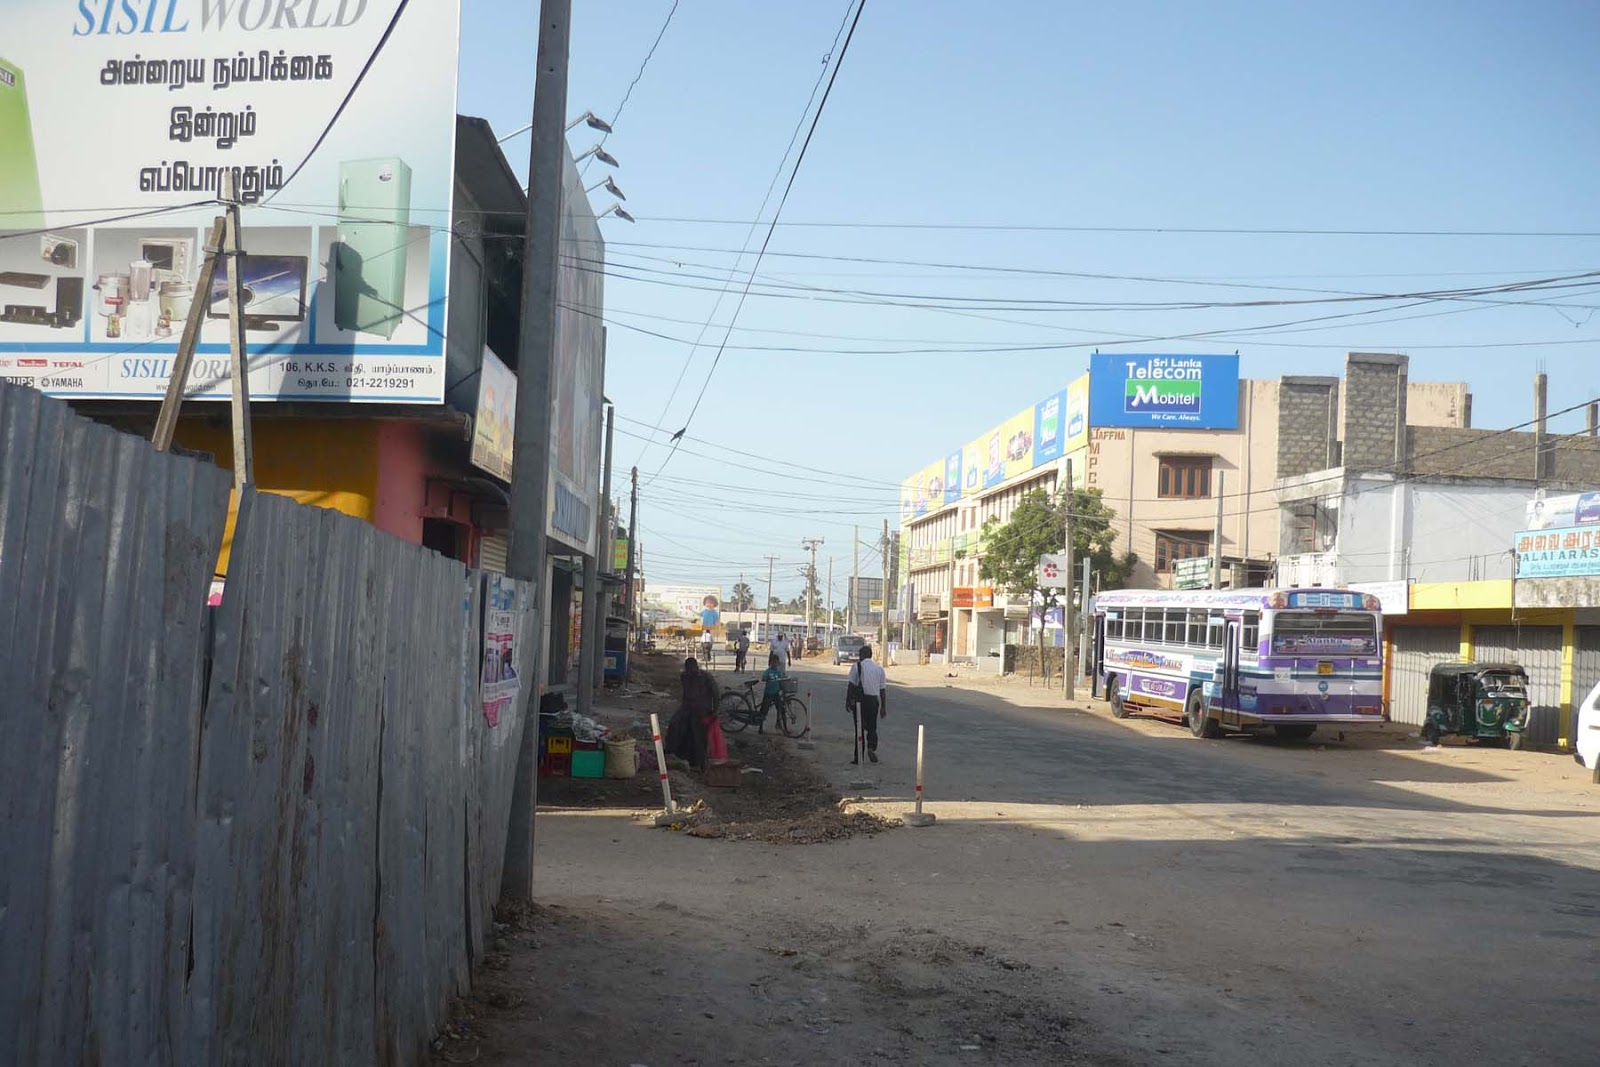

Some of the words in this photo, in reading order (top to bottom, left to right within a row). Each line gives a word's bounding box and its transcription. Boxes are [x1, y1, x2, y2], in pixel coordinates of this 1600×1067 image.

[100, 54, 205, 91] அன்றைய
[213, 50, 333, 90] நம்பிக்கை
[169, 105, 256, 149] இன்றும்
[1126, 361, 1202, 380] Telecom
[1153, 359, 1168, 368] Sri
[1171, 359, 1202, 368] Lanka
[51, 378, 84, 388] YAMAHA
[346, 377, 415, 389] 021-2219291
[1131, 385, 1196, 407] Mobitel
